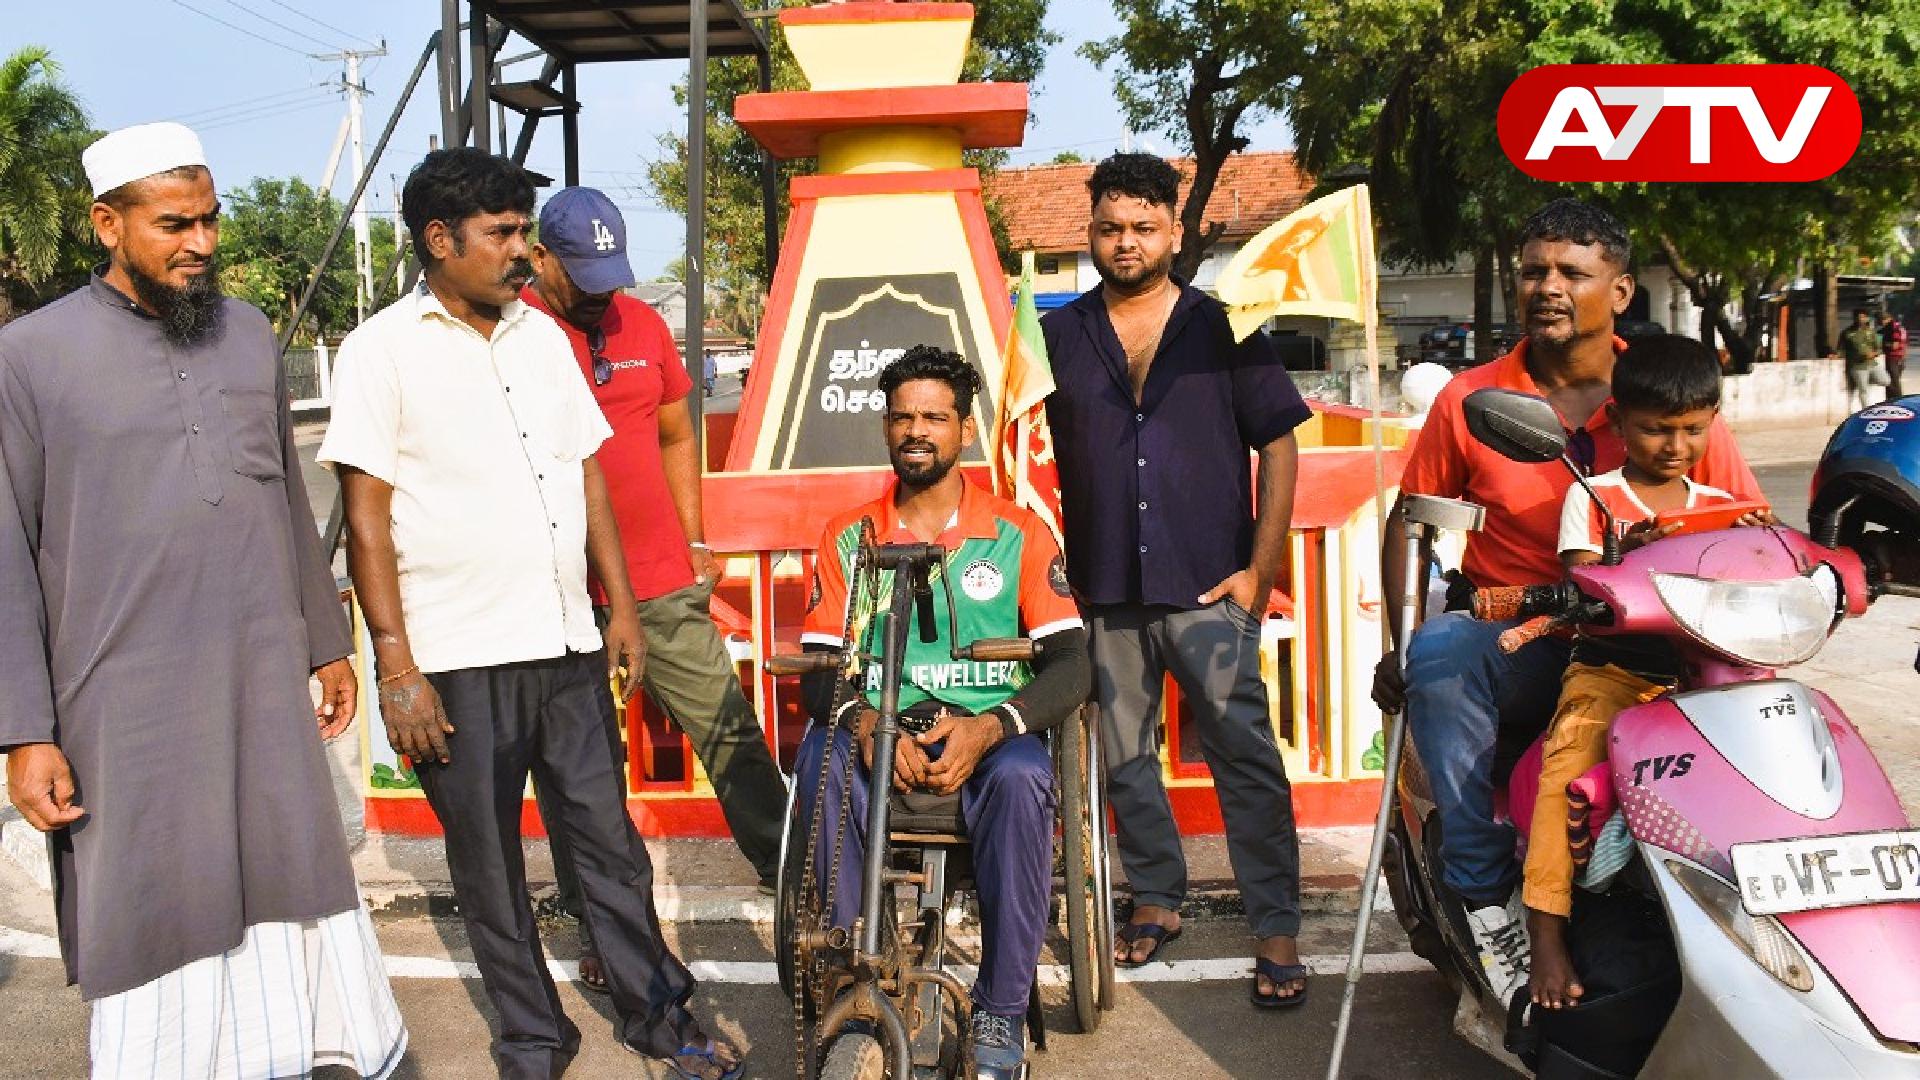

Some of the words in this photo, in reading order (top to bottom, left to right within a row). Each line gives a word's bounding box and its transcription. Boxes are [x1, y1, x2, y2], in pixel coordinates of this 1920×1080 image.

[592, 219, 616, 250] LA
[1760, 704, 1796, 718] TVS
[1632, 753, 1696, 786] TVS
